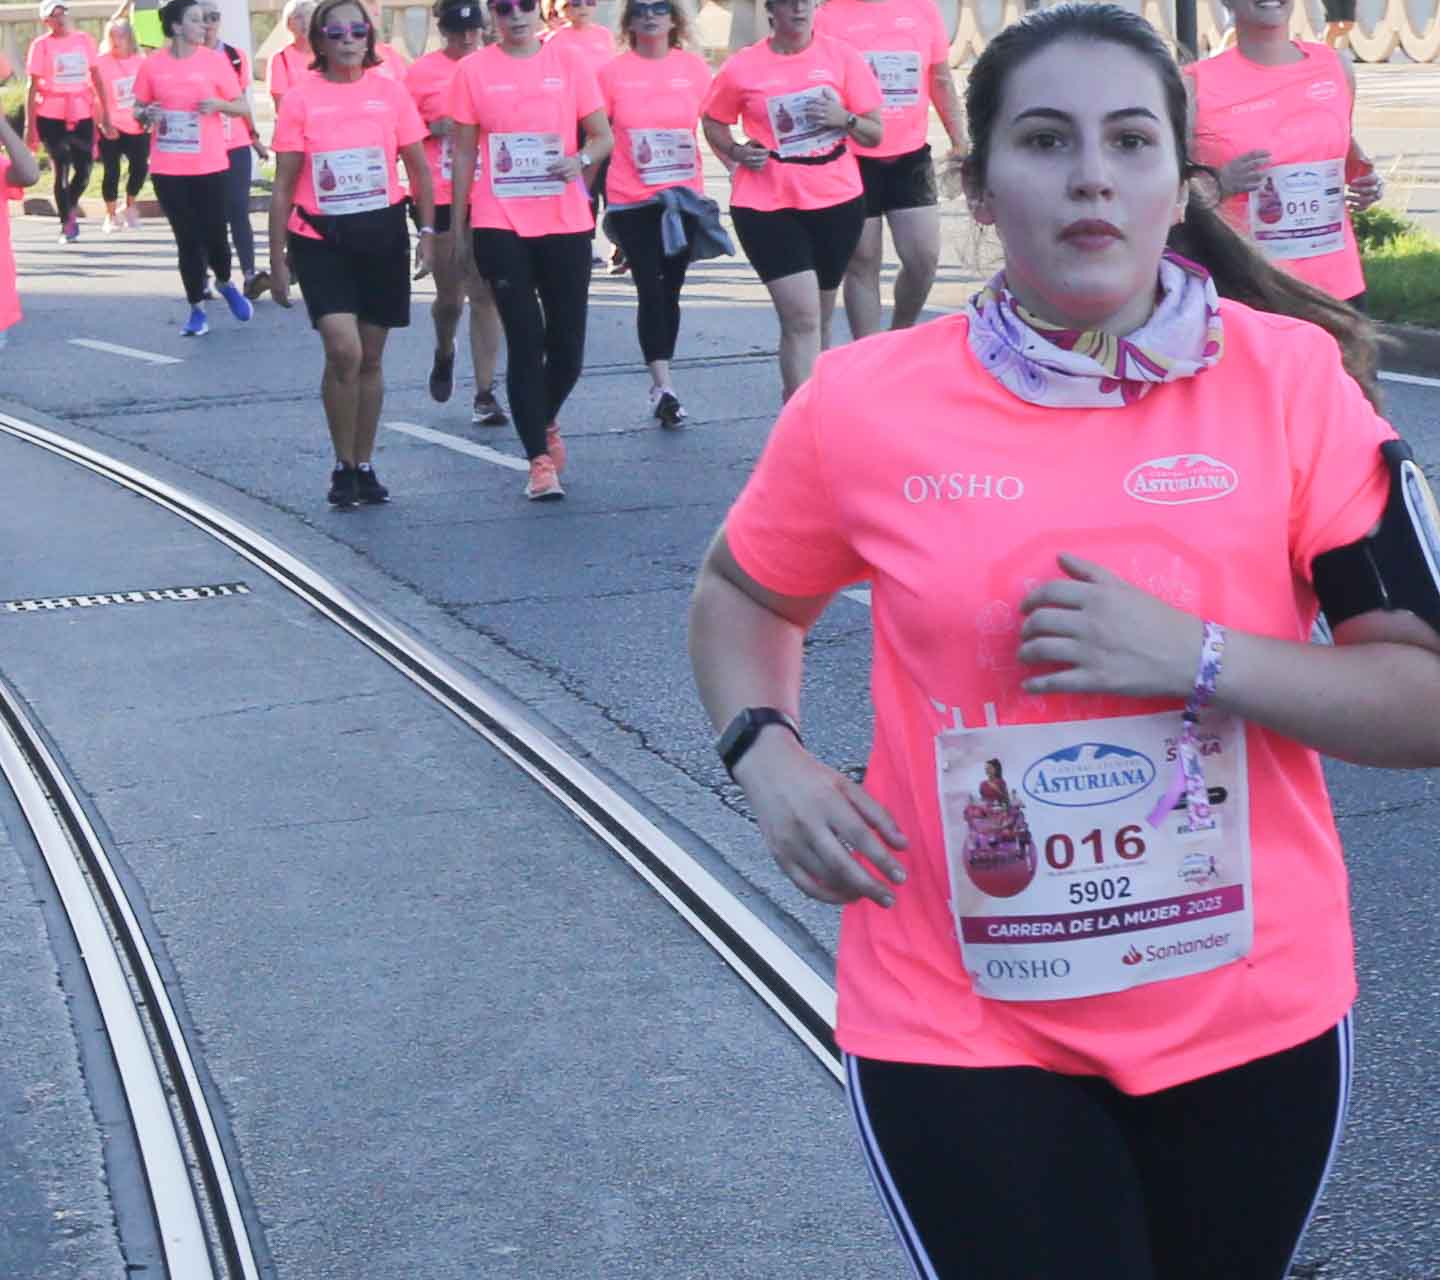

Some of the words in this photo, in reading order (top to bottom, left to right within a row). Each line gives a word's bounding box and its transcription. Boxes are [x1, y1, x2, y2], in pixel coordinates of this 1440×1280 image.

[1286, 199, 1320, 215] 016
[903, 473, 1025, 504] OYSHO
[1044, 824, 1147, 870] 016
[1068, 876, 1132, 905] 5902
[987, 922, 1065, 937] CARRERA
[1069, 919, 1092, 933] DE
[1098, 915, 1121, 930] LA
[1123, 905, 1180, 926] MUJER
[1186, 895, 1223, 916] 2023
[1145, 931, 1231, 962] Santander
[986, 957, 1071, 980] OYSHO
